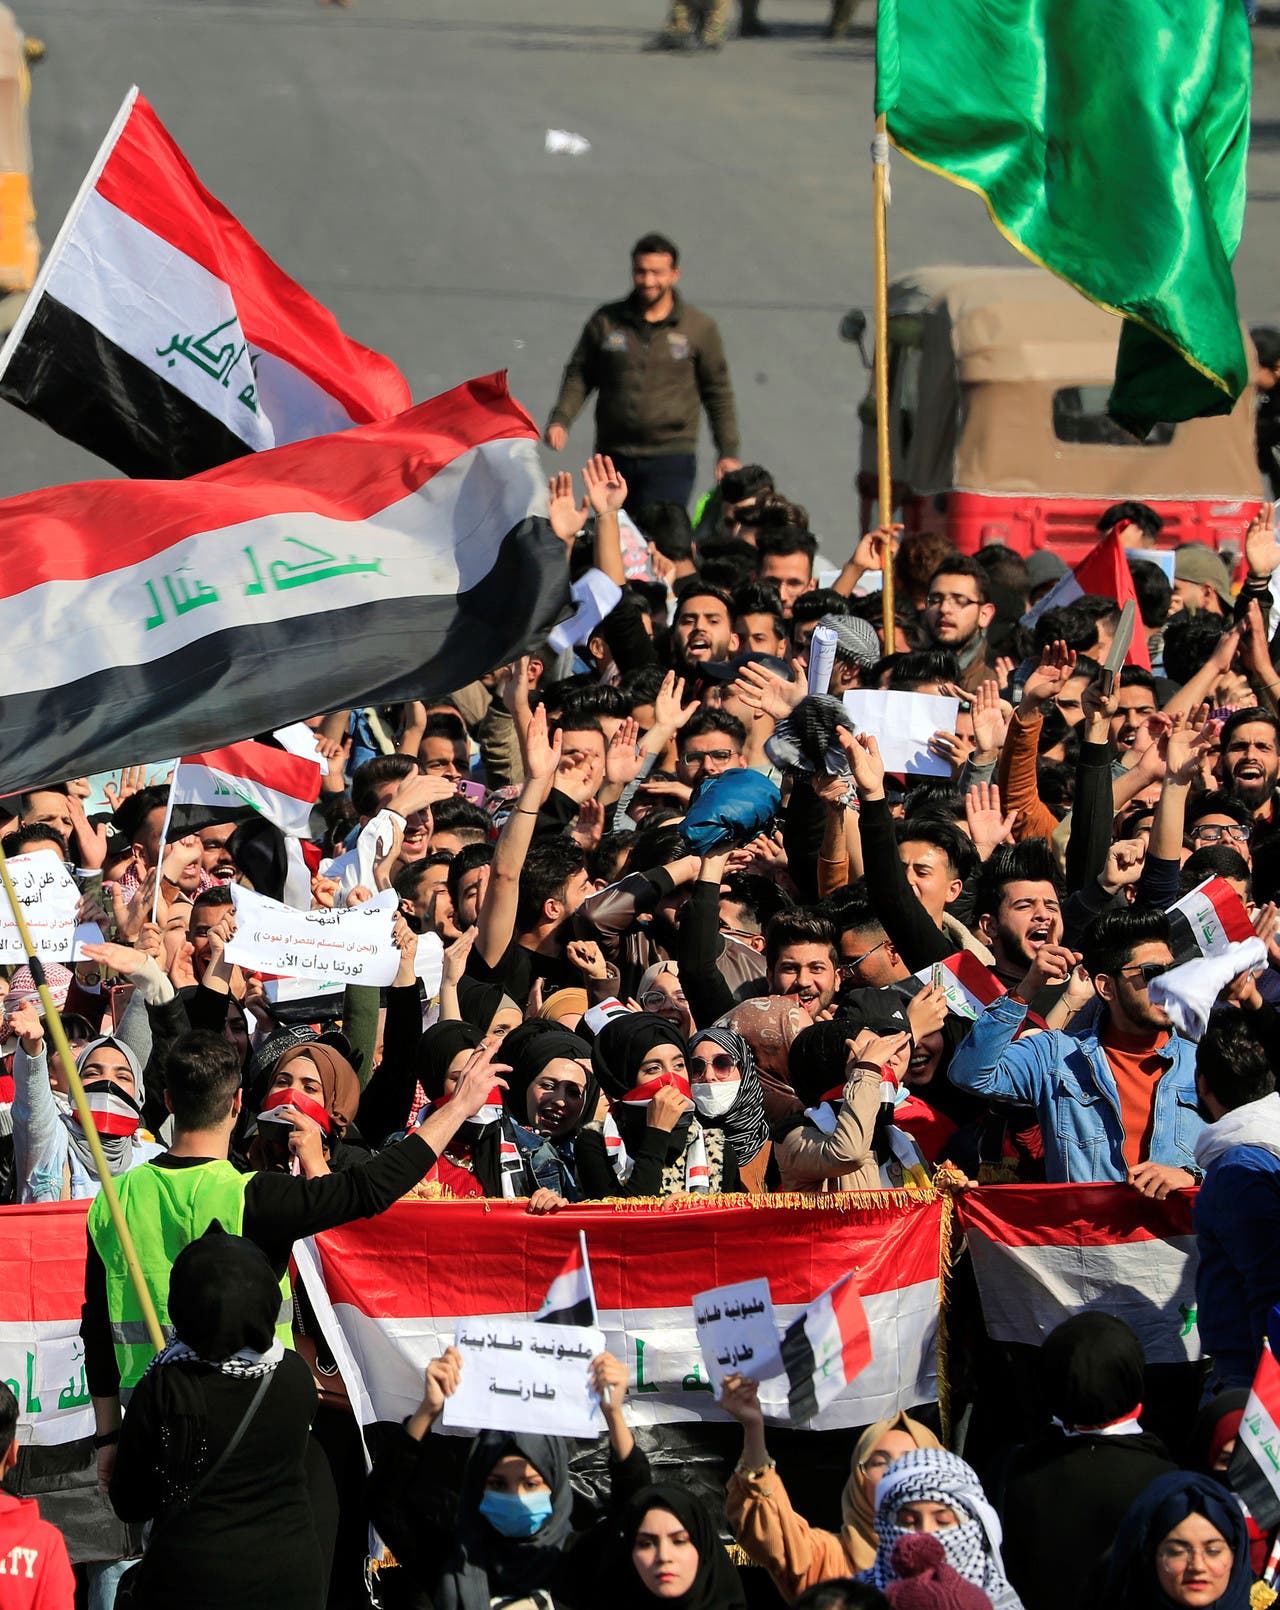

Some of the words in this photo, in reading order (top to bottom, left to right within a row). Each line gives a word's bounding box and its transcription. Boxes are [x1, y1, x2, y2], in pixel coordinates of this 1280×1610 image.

[301, 955, 329, 970] بدأت
[333, 958, 364, 976] ثورتنا
[724, 1297, 765, 1322] مليونية
[530, 1336, 593, 1361] مليونية
